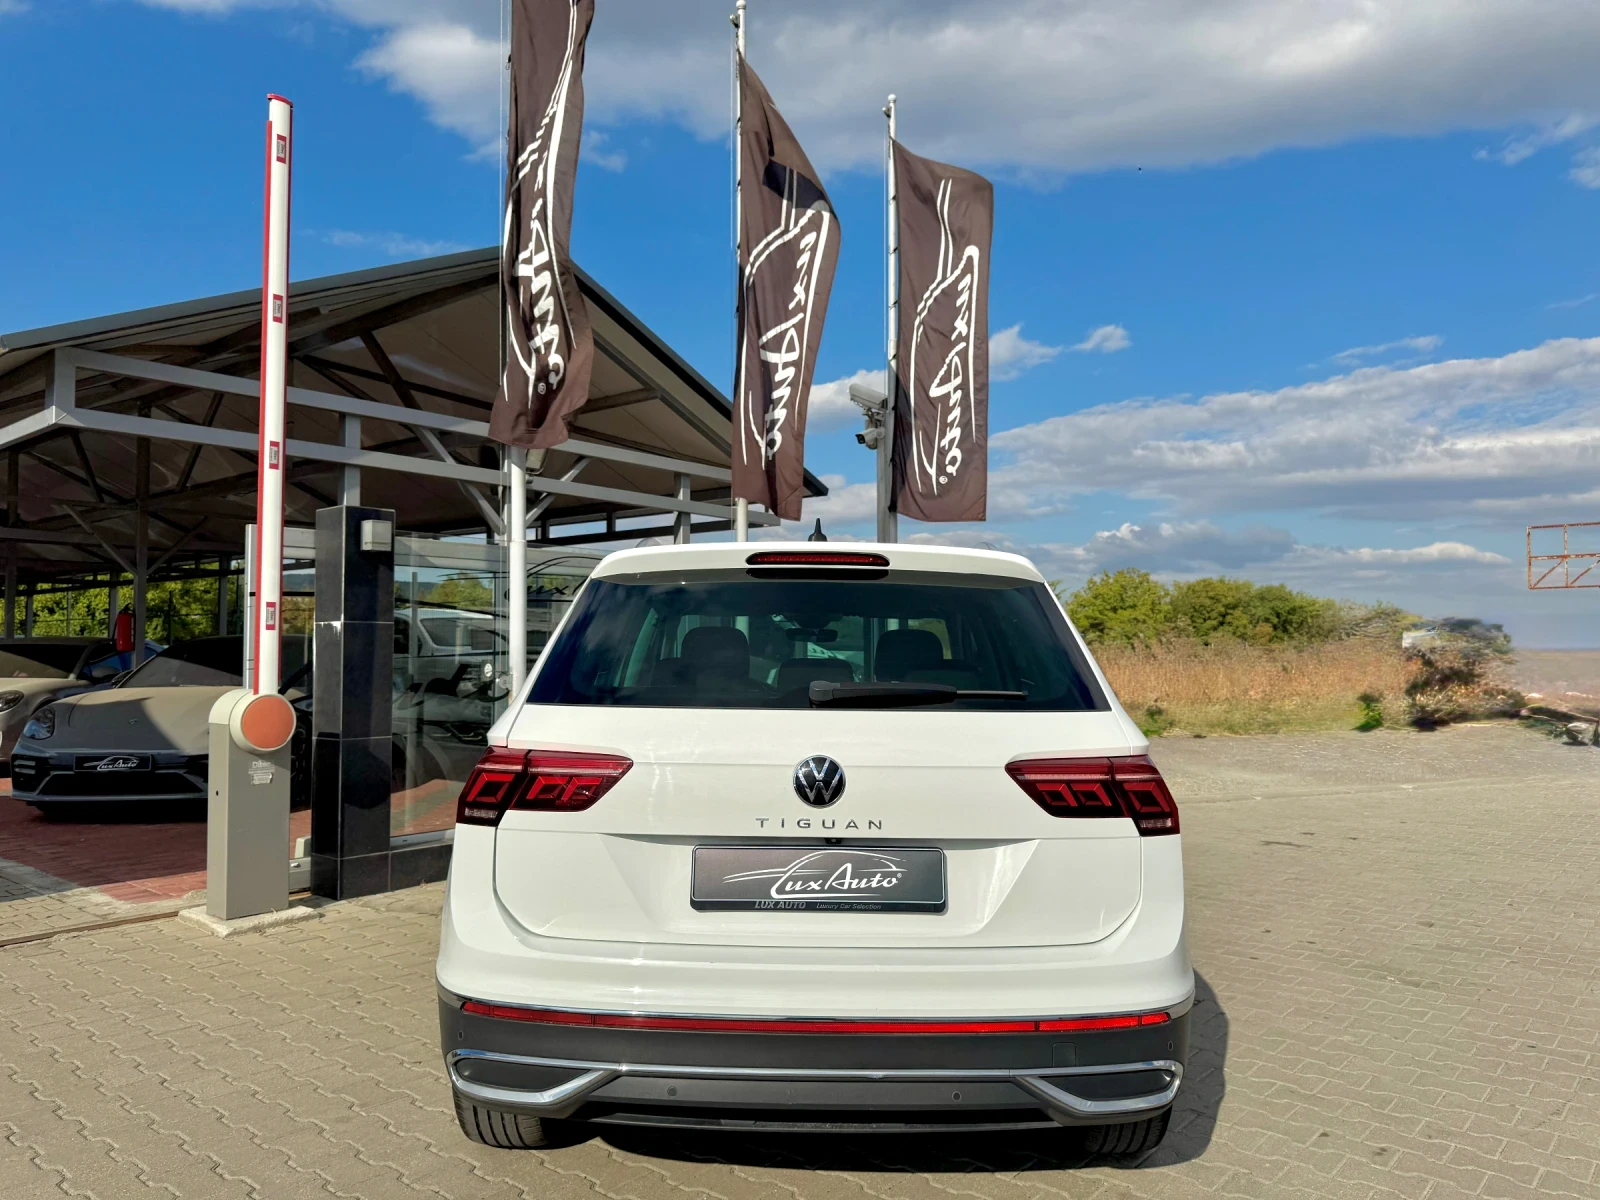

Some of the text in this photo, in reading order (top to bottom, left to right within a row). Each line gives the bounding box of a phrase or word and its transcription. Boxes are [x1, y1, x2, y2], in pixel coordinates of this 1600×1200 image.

[755, 817, 883, 831] TIGUAN
[754, 901, 775, 909] LUX
[778, 901, 807, 910] AUTO
